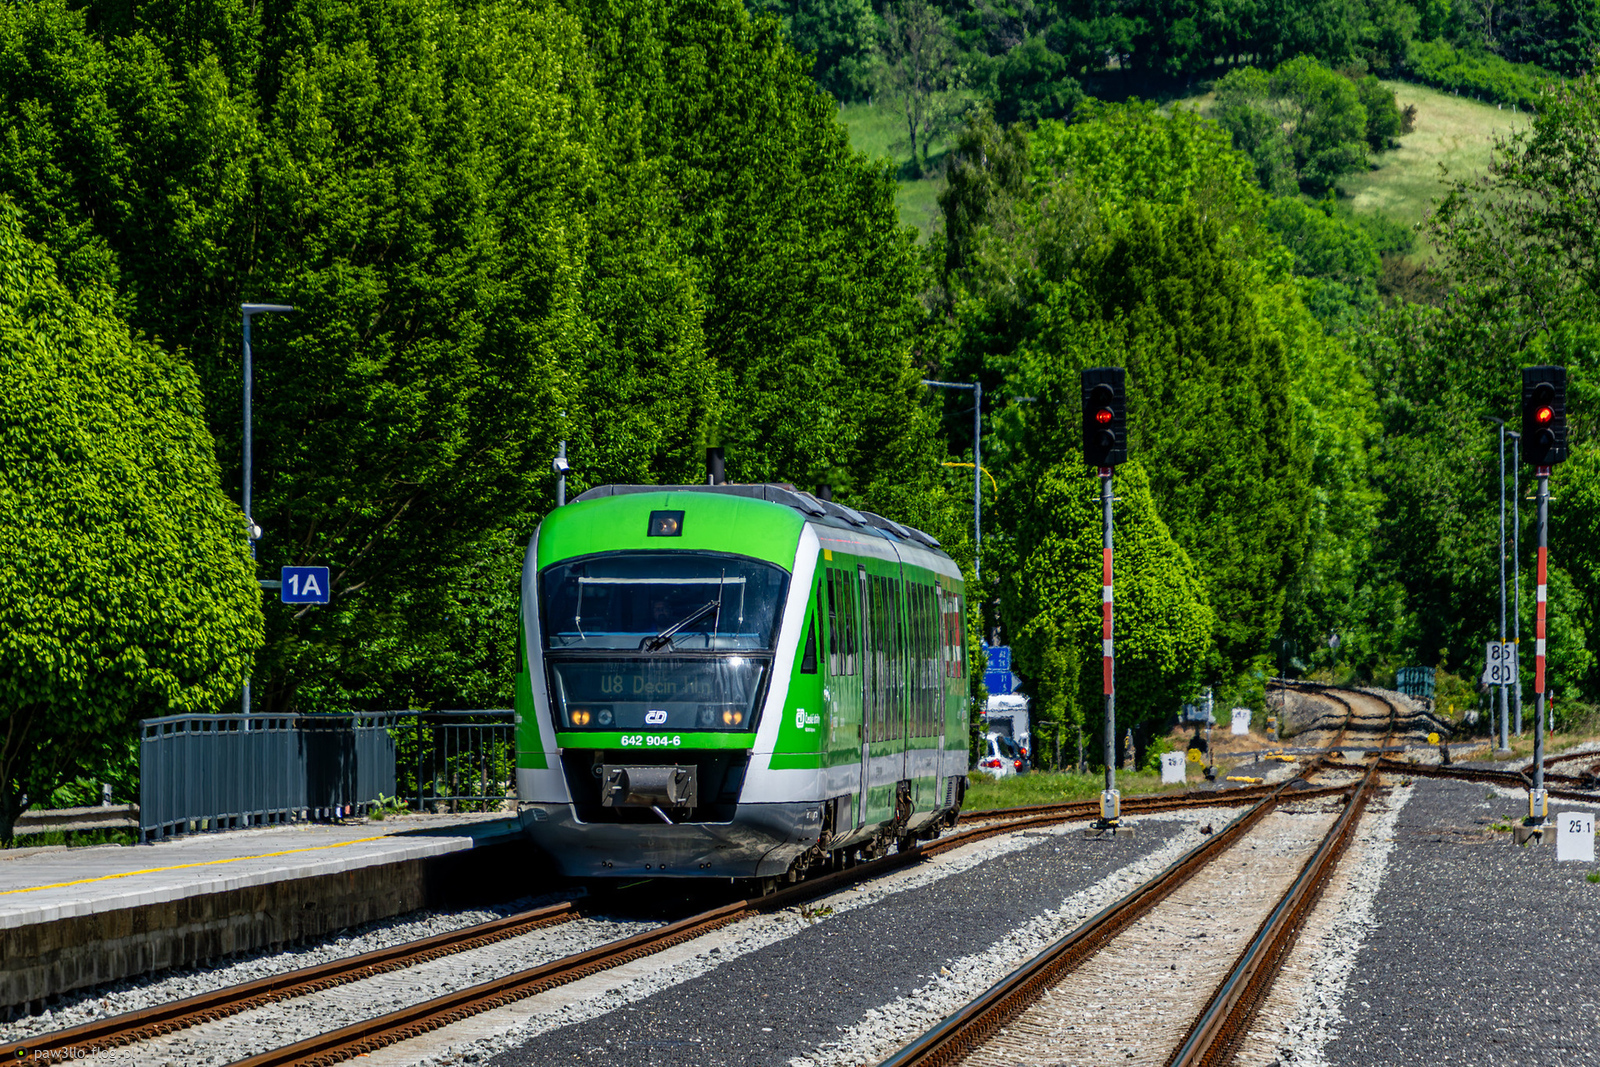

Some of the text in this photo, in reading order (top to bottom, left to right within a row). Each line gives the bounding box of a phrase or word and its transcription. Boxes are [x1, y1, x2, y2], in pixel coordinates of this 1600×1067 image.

[288, 574, 322, 596] 1A
[601, 675, 623, 693] U8
[621, 735, 681, 746] 642 904-6
[1569, 819, 1591, 833] 25.1
